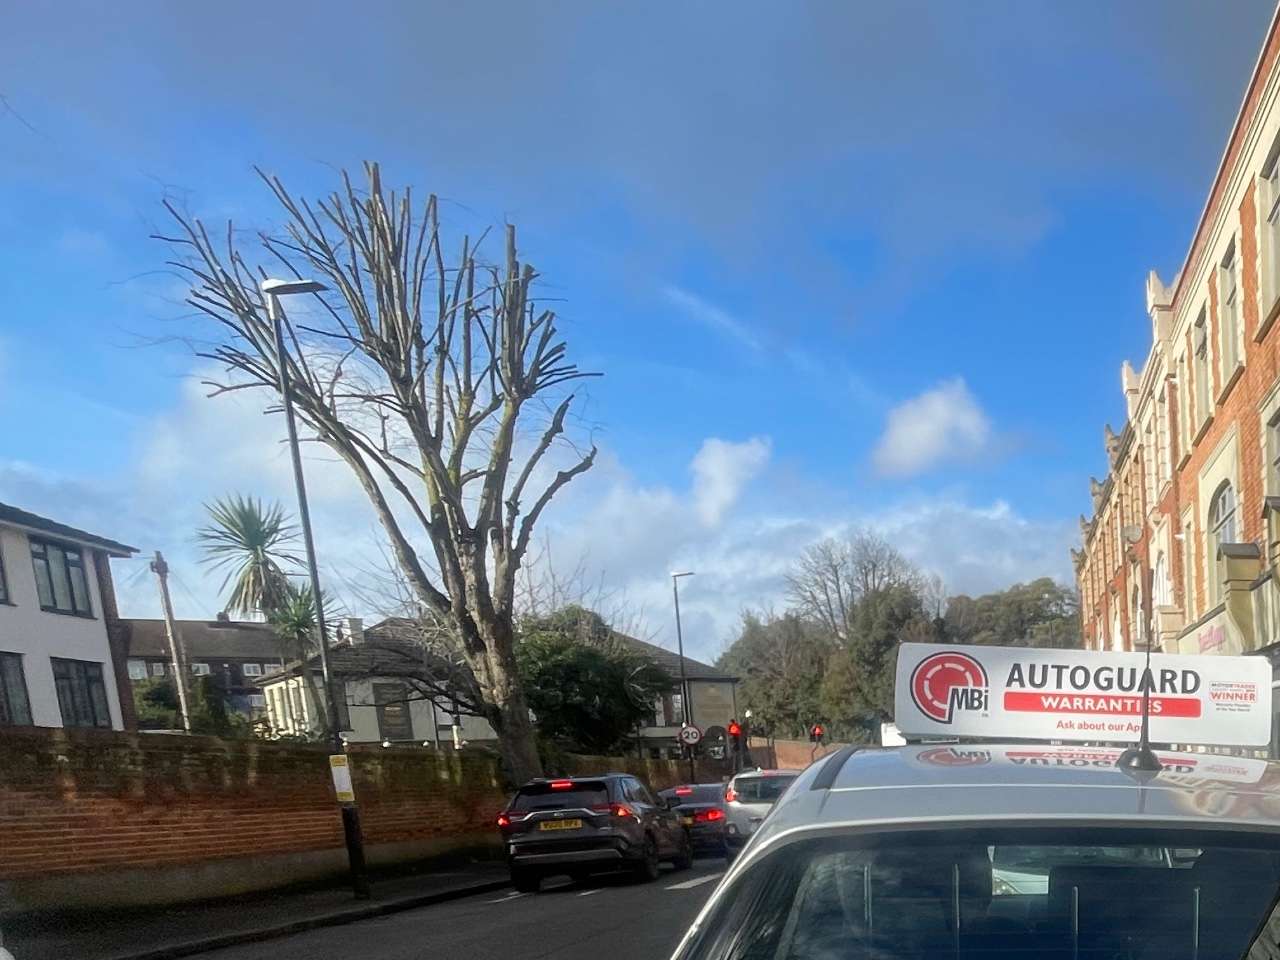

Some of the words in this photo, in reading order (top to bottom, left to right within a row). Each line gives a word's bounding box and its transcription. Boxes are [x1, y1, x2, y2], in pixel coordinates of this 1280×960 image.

[1006, 663, 1200, 695] AUTOGUARD
[1211, 691, 1256, 701] WINNER
[1057, 720, 1075, 730] Ask
[1078, 721, 1105, 731] about
[1110, 724, 1124, 732] our
[1127, 724, 1143, 734] Ap
[684, 731, 698, 739] 20
